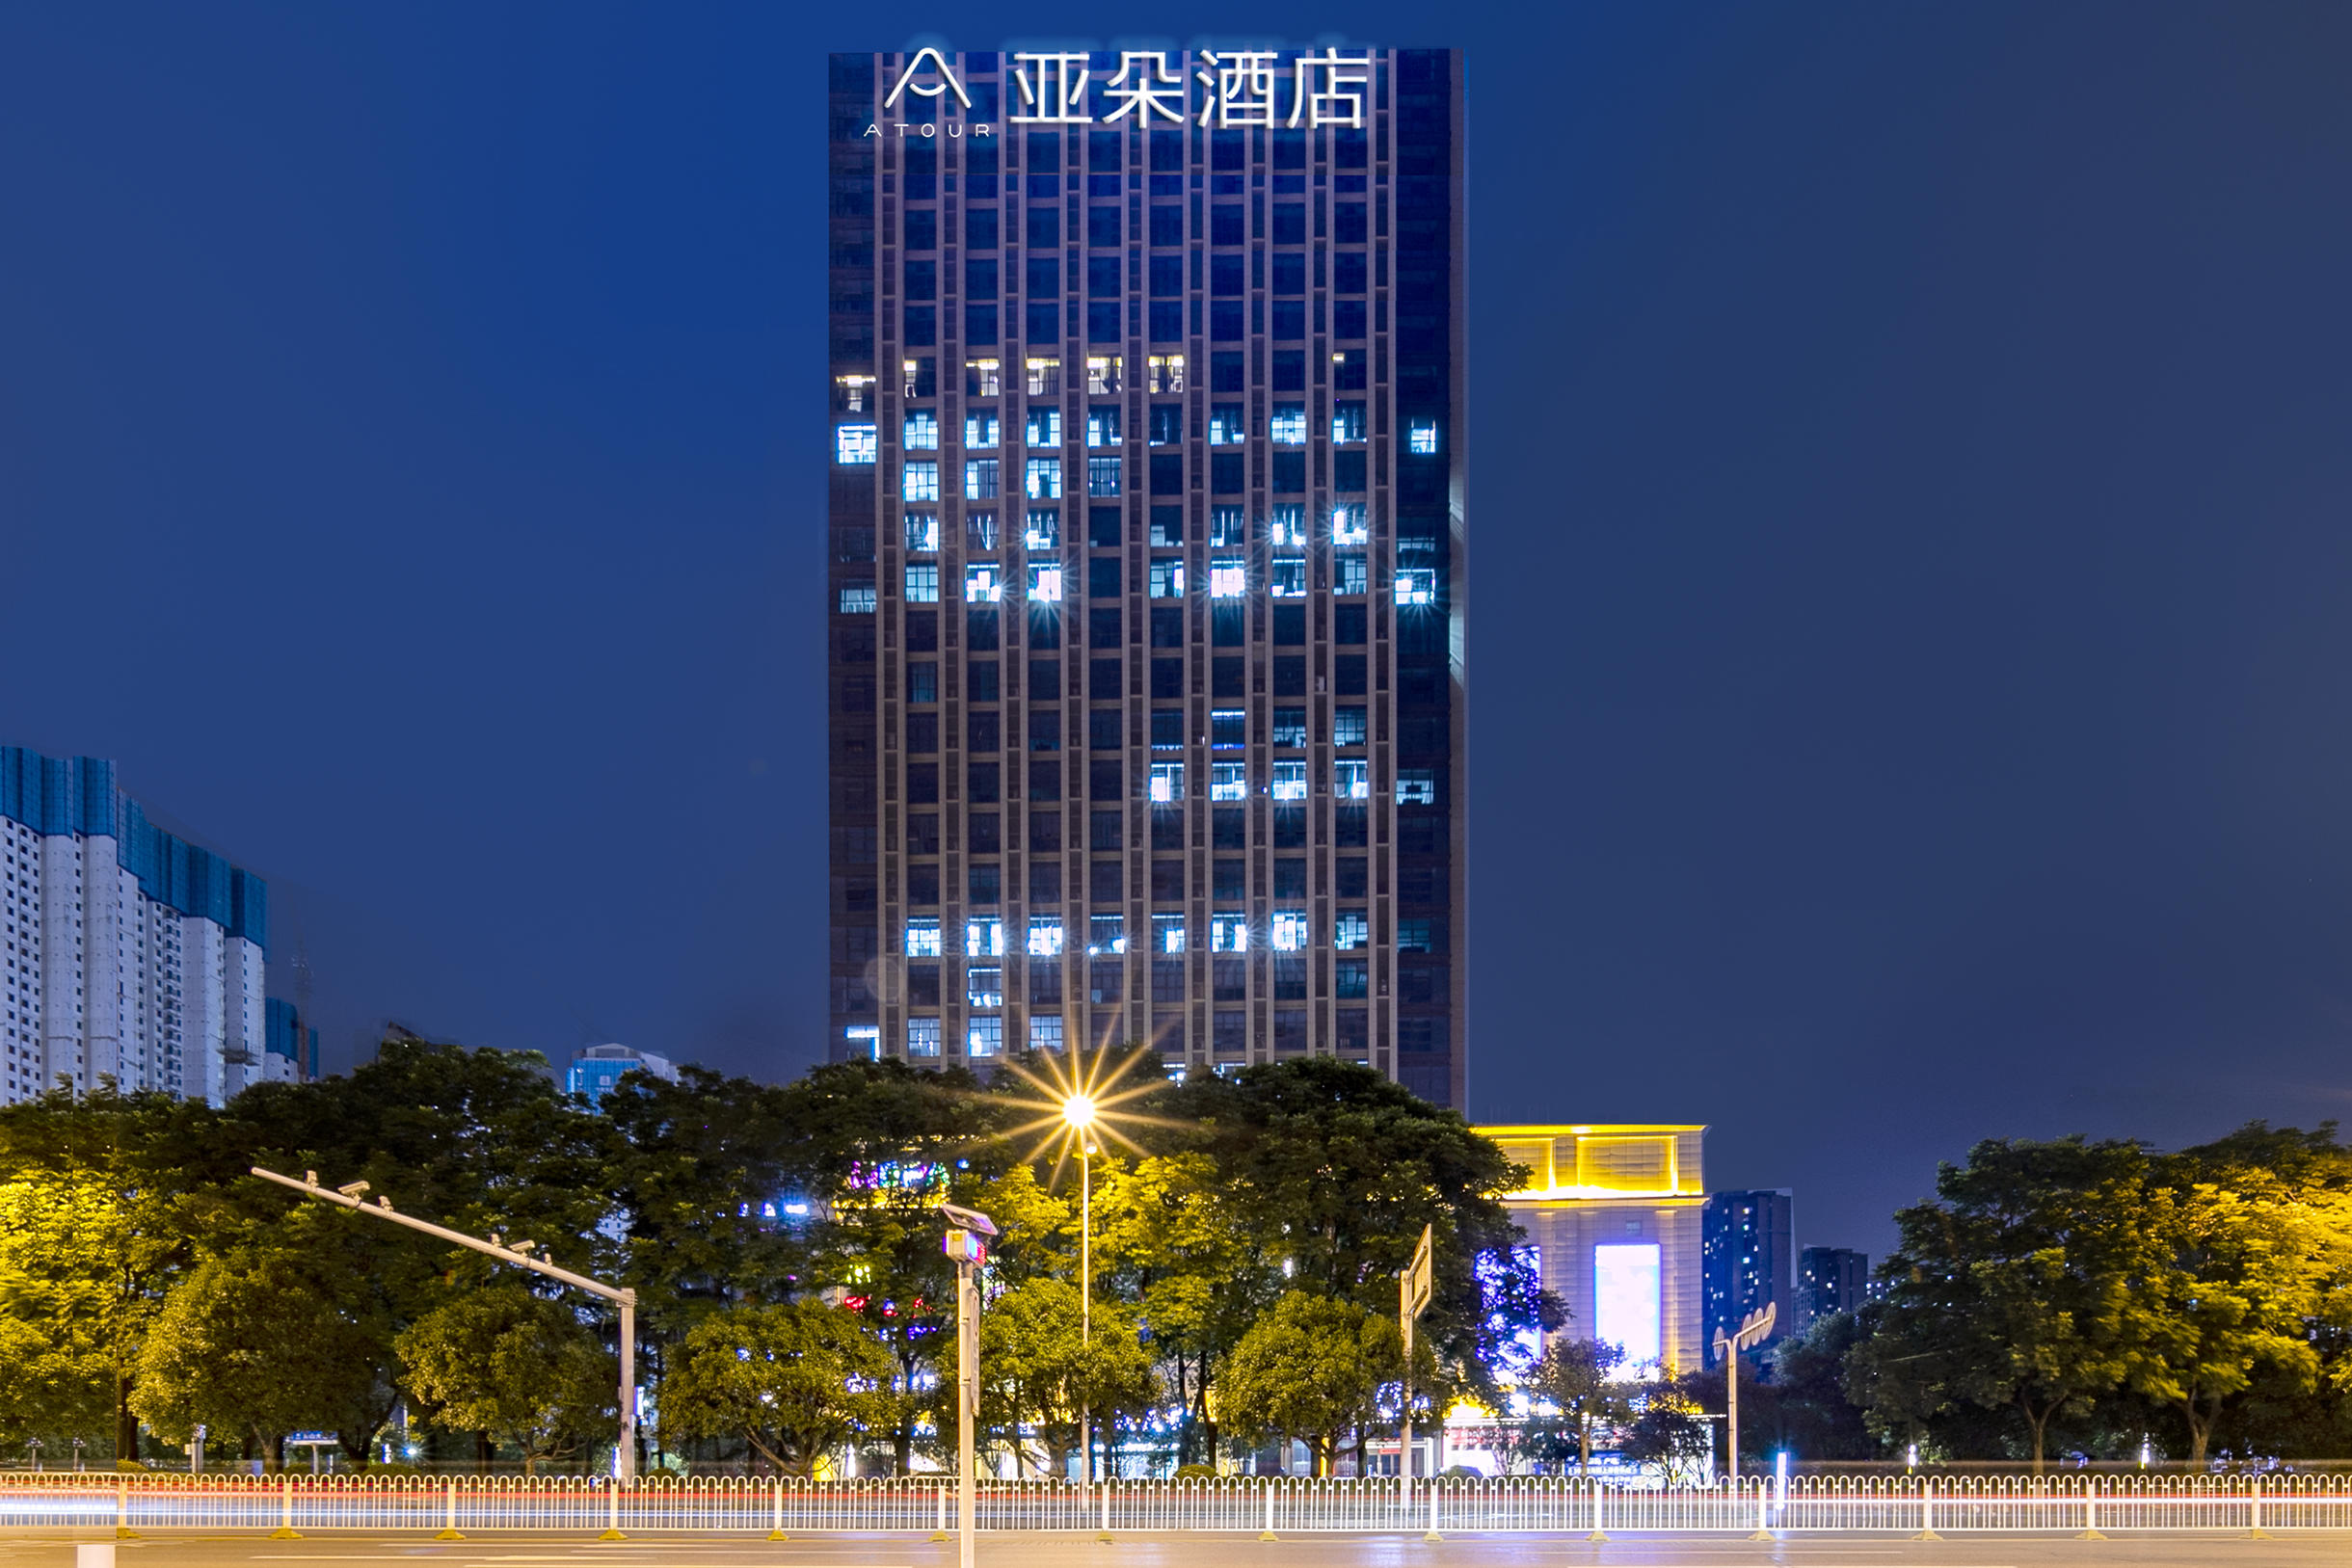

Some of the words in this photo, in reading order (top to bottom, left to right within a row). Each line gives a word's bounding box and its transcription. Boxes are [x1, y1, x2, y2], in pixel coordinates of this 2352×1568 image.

[1009, 47, 1371, 130] 亚朵酒店
[863, 123, 990, 138] ATOUR
